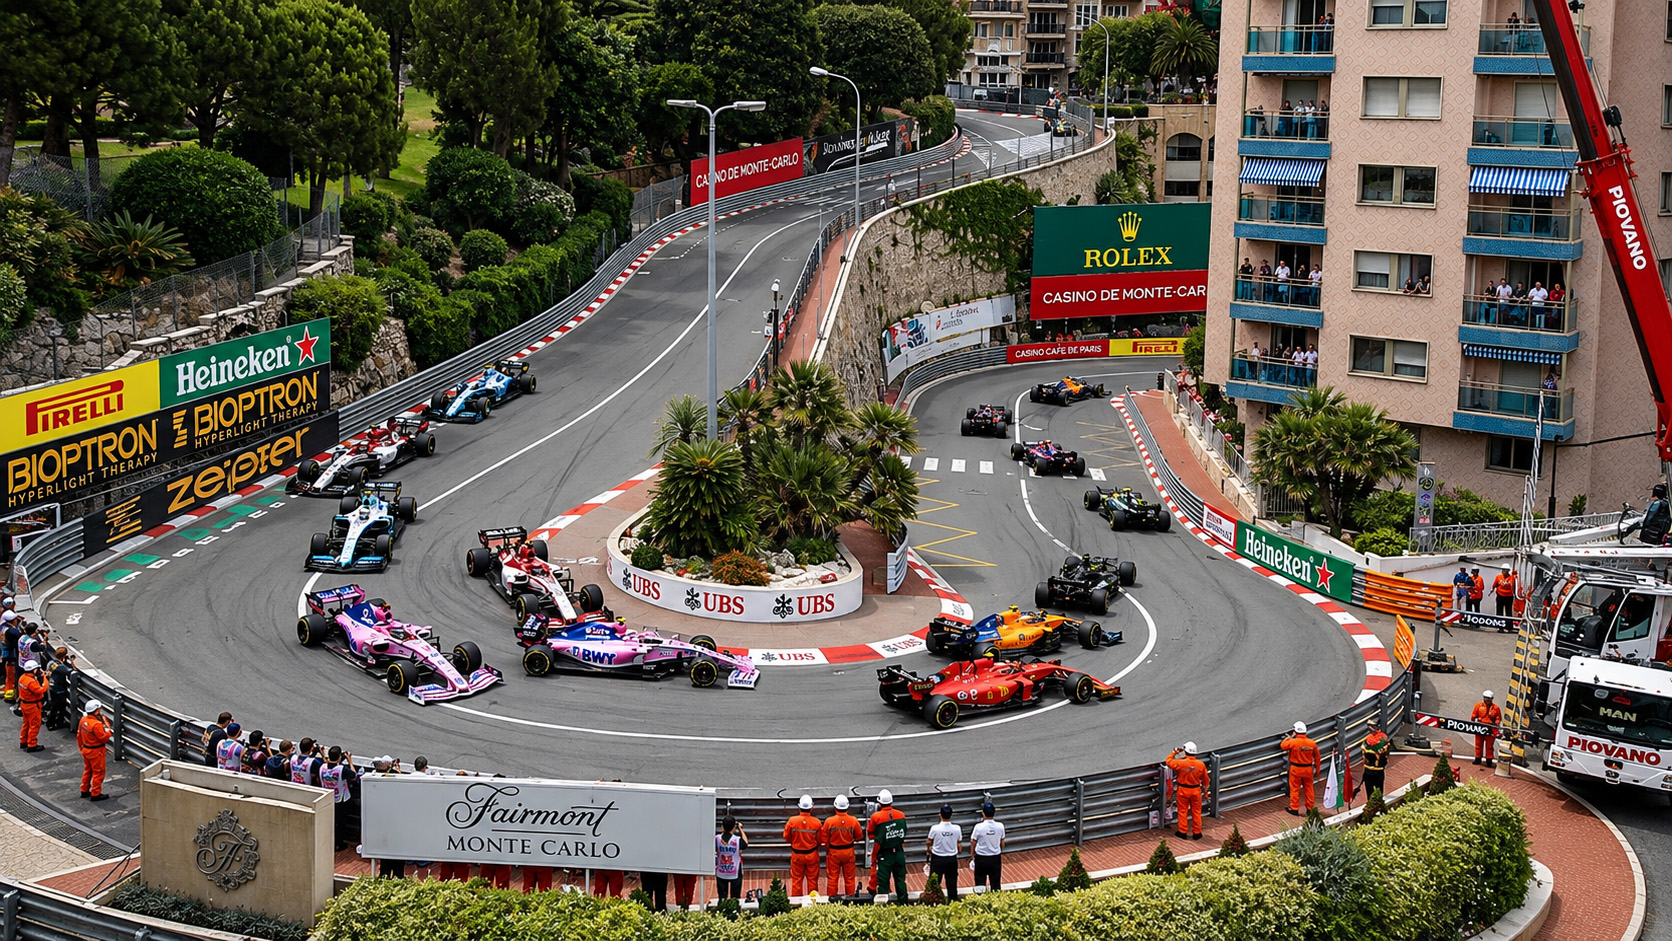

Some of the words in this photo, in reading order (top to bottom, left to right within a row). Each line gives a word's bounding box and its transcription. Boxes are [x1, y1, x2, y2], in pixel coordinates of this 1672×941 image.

[696, 169, 726, 188] CANO
[728, 166, 740, 180] DE
[740, 152, 799, 177] MONTE-CARLO
[1608, 185, 1647, 270] PIOVANO
[1084, 246, 1173, 268] ROLEX
[1043, 290, 1097, 304] CASINO
[1100, 289, 1120, 301] DE
[1123, 285, 1206, 300] MONTE-CAR
[1015, 348, 1044, 358] CASINO
[1068, 346, 1078, 354] DE
[1080, 345, 1102, 354] PARIS
[176, 346, 291, 396] Heineken
[25, 379, 124, 436] PIRELLI
[194, 371, 318, 437] BIOPTRON
[195, 416, 268, 449] HYPERLIGHT
[271, 401, 318, 424] THERAPY
[8, 419, 158, 495] BIOPTRON
[8, 472, 95, 508] HYPERLIGHT
[101, 452, 158, 479] THERAPY
[1245, 528, 1312, 584] Heineken
[632, 573, 661, 600] UBS
[704, 592, 744, 615] UBS
[797, 593, 835, 616] UBS
[778, 652, 816, 661] UBS
[1600, 707, 1637, 722] MAN
[1568, 736, 1661, 766] PIOVANO
[446, 782, 620, 838] Fairmont
[446, 835, 532, 855] MONTE
[540, 840, 621, 858] CARLO
